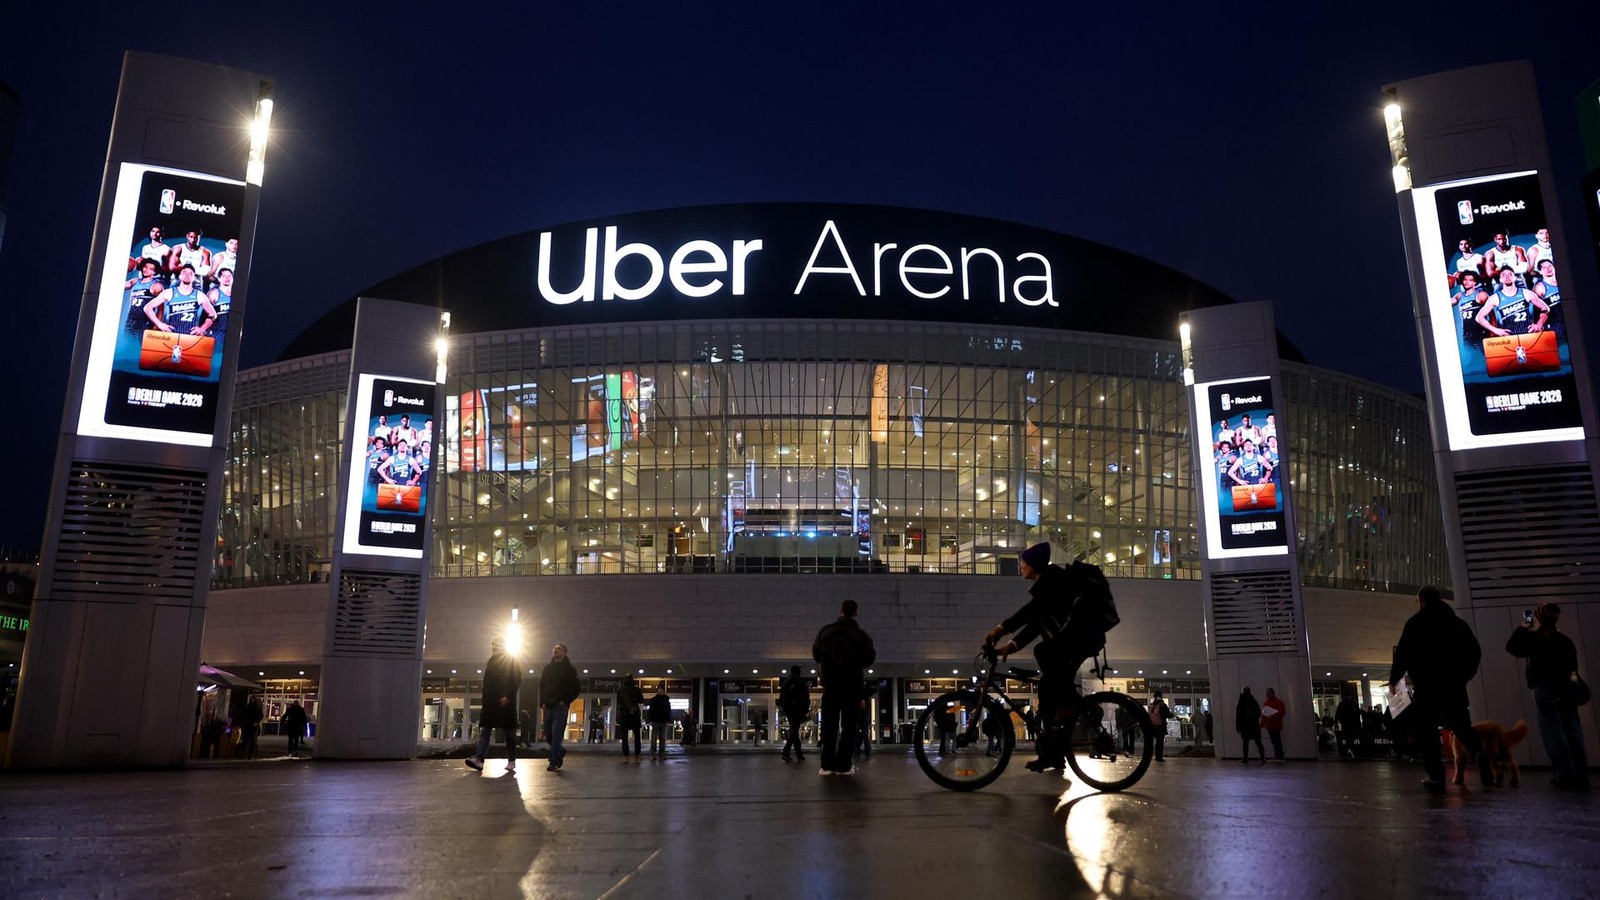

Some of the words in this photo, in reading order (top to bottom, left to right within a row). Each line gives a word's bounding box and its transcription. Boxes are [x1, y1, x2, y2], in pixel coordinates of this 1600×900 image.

[183, 200, 226, 215] Revolut
[1481, 200, 1525, 215] Revolut
[537, 225, 763, 305] Uber
[794, 220, 1059, 307] Arena
[180, 313, 195, 322] 22
[1514, 312, 1527, 322] 22
[182, 393, 204, 407] 2026
[398, 396, 425, 406] Revolut
[1235, 395, 1262, 404] Revolut
[1493, 394, 1519, 408] BERLIN
[1519, 391, 1541, 405] GAME
[1540, 389, 1563, 404] 2026
[0, 616, 17, 629] THE
[1149, 680, 1172, 688] Eingang
